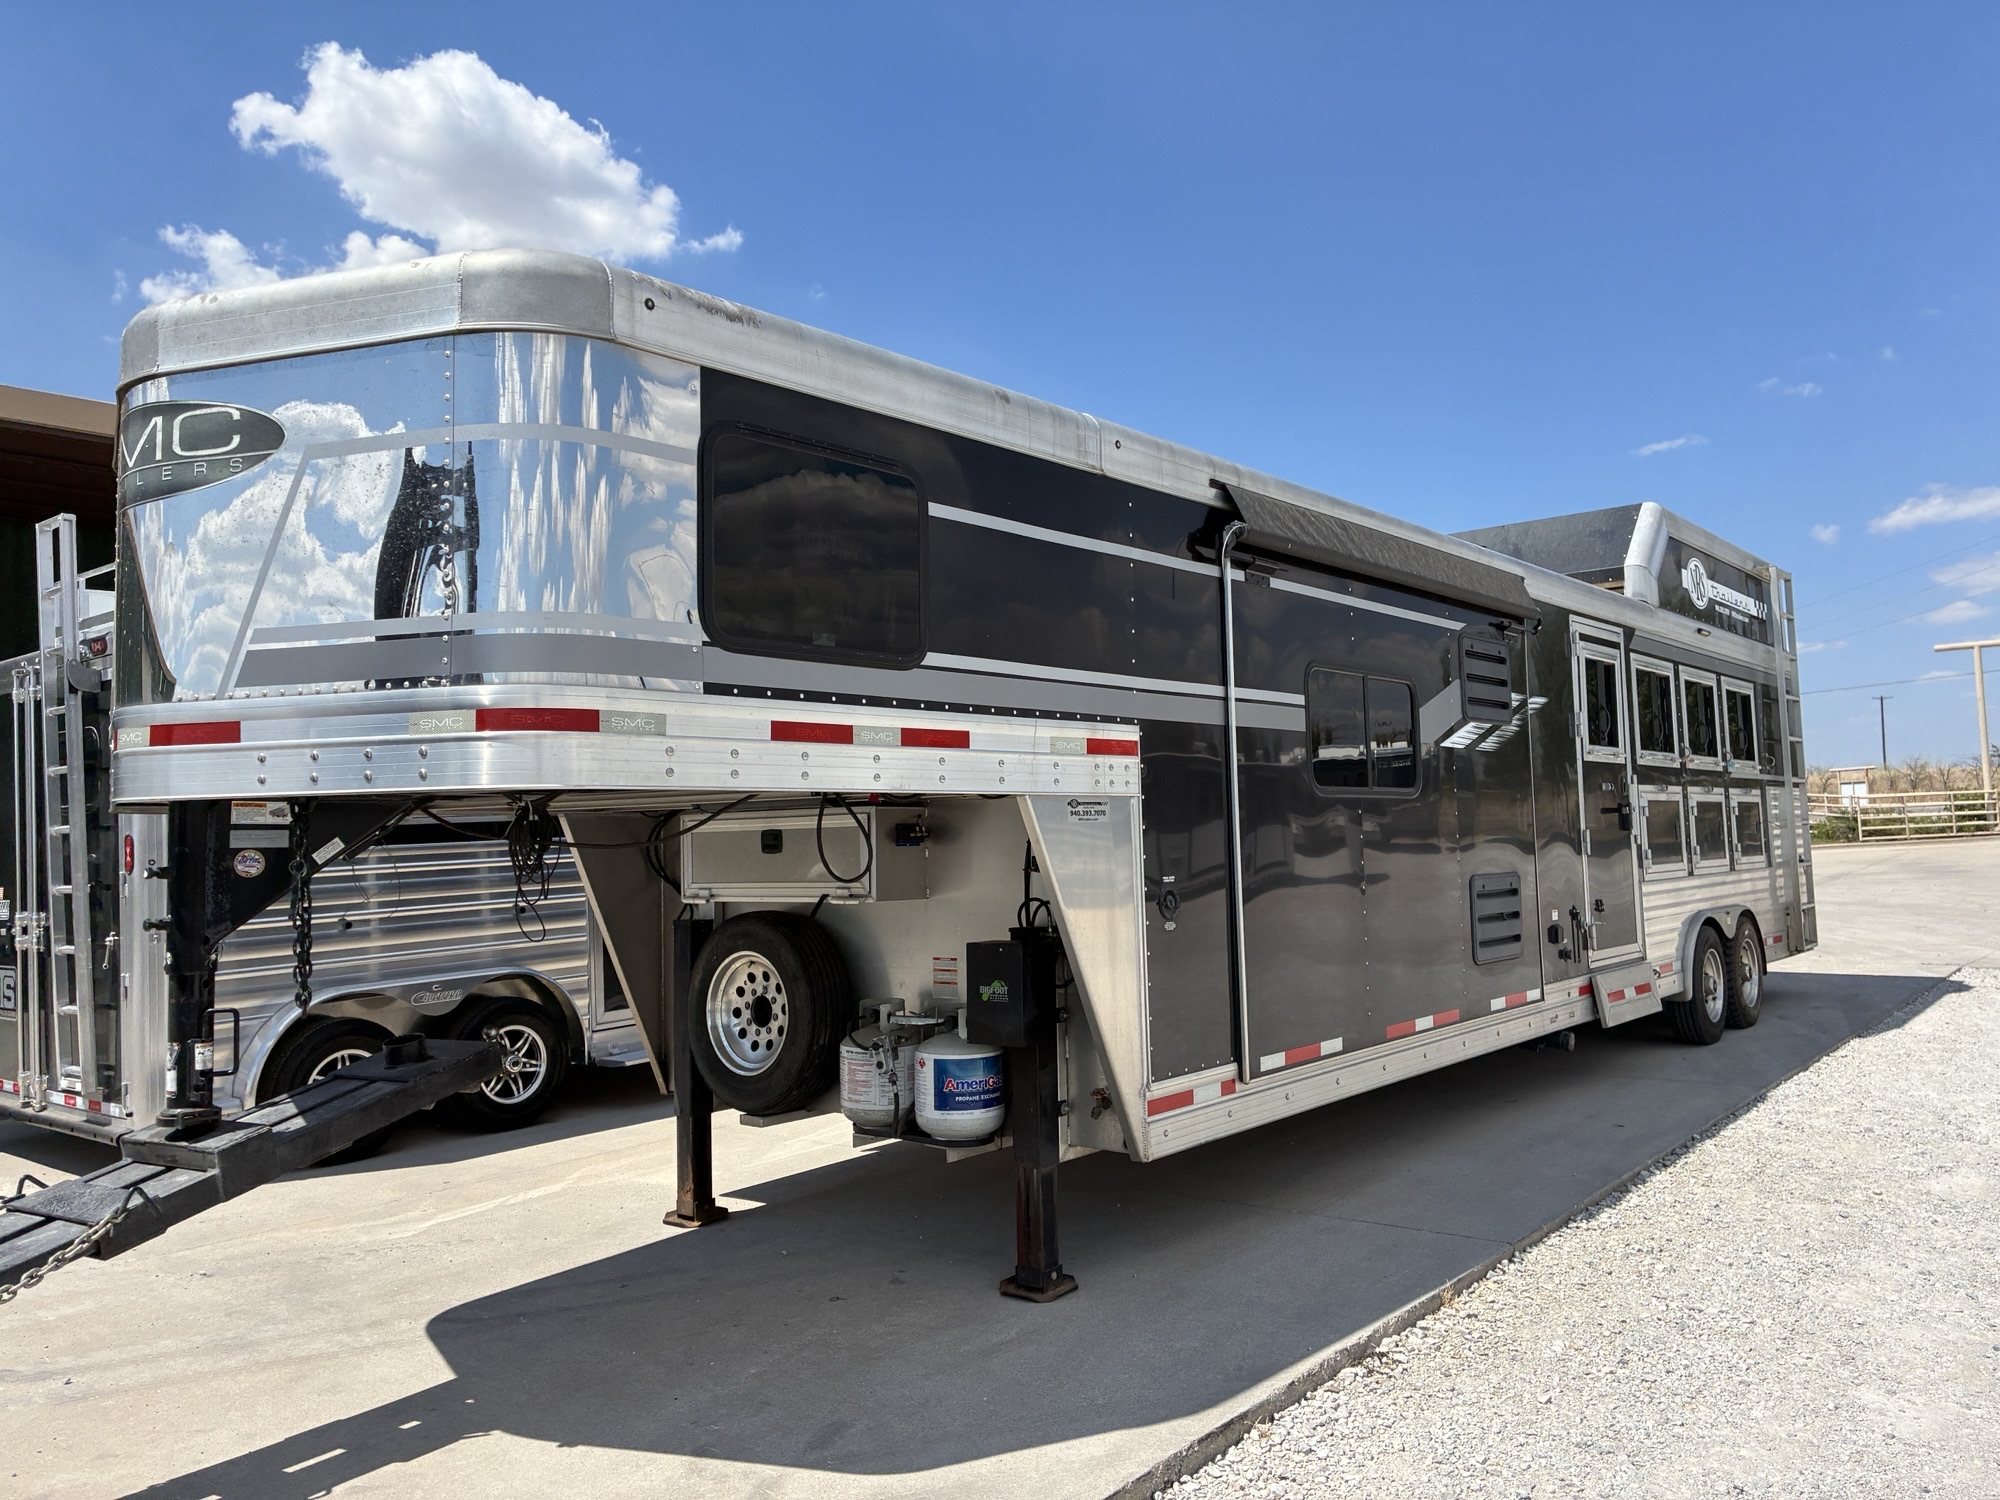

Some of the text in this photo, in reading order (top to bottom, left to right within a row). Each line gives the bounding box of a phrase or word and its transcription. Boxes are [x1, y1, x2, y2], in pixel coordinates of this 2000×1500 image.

[419, 717, 463, 728] SMC
[510, 714, 565, 725] SMC
[611, 717, 655, 728] SMC
[119, 732, 142, 743] SMC
[861, 731, 893, 740] SMC
[1056, 741, 1081, 750] SMC
[1069, 809, 1107, 817] 940.393.7070
[979, 985, 1009, 995] BIGFOOT
